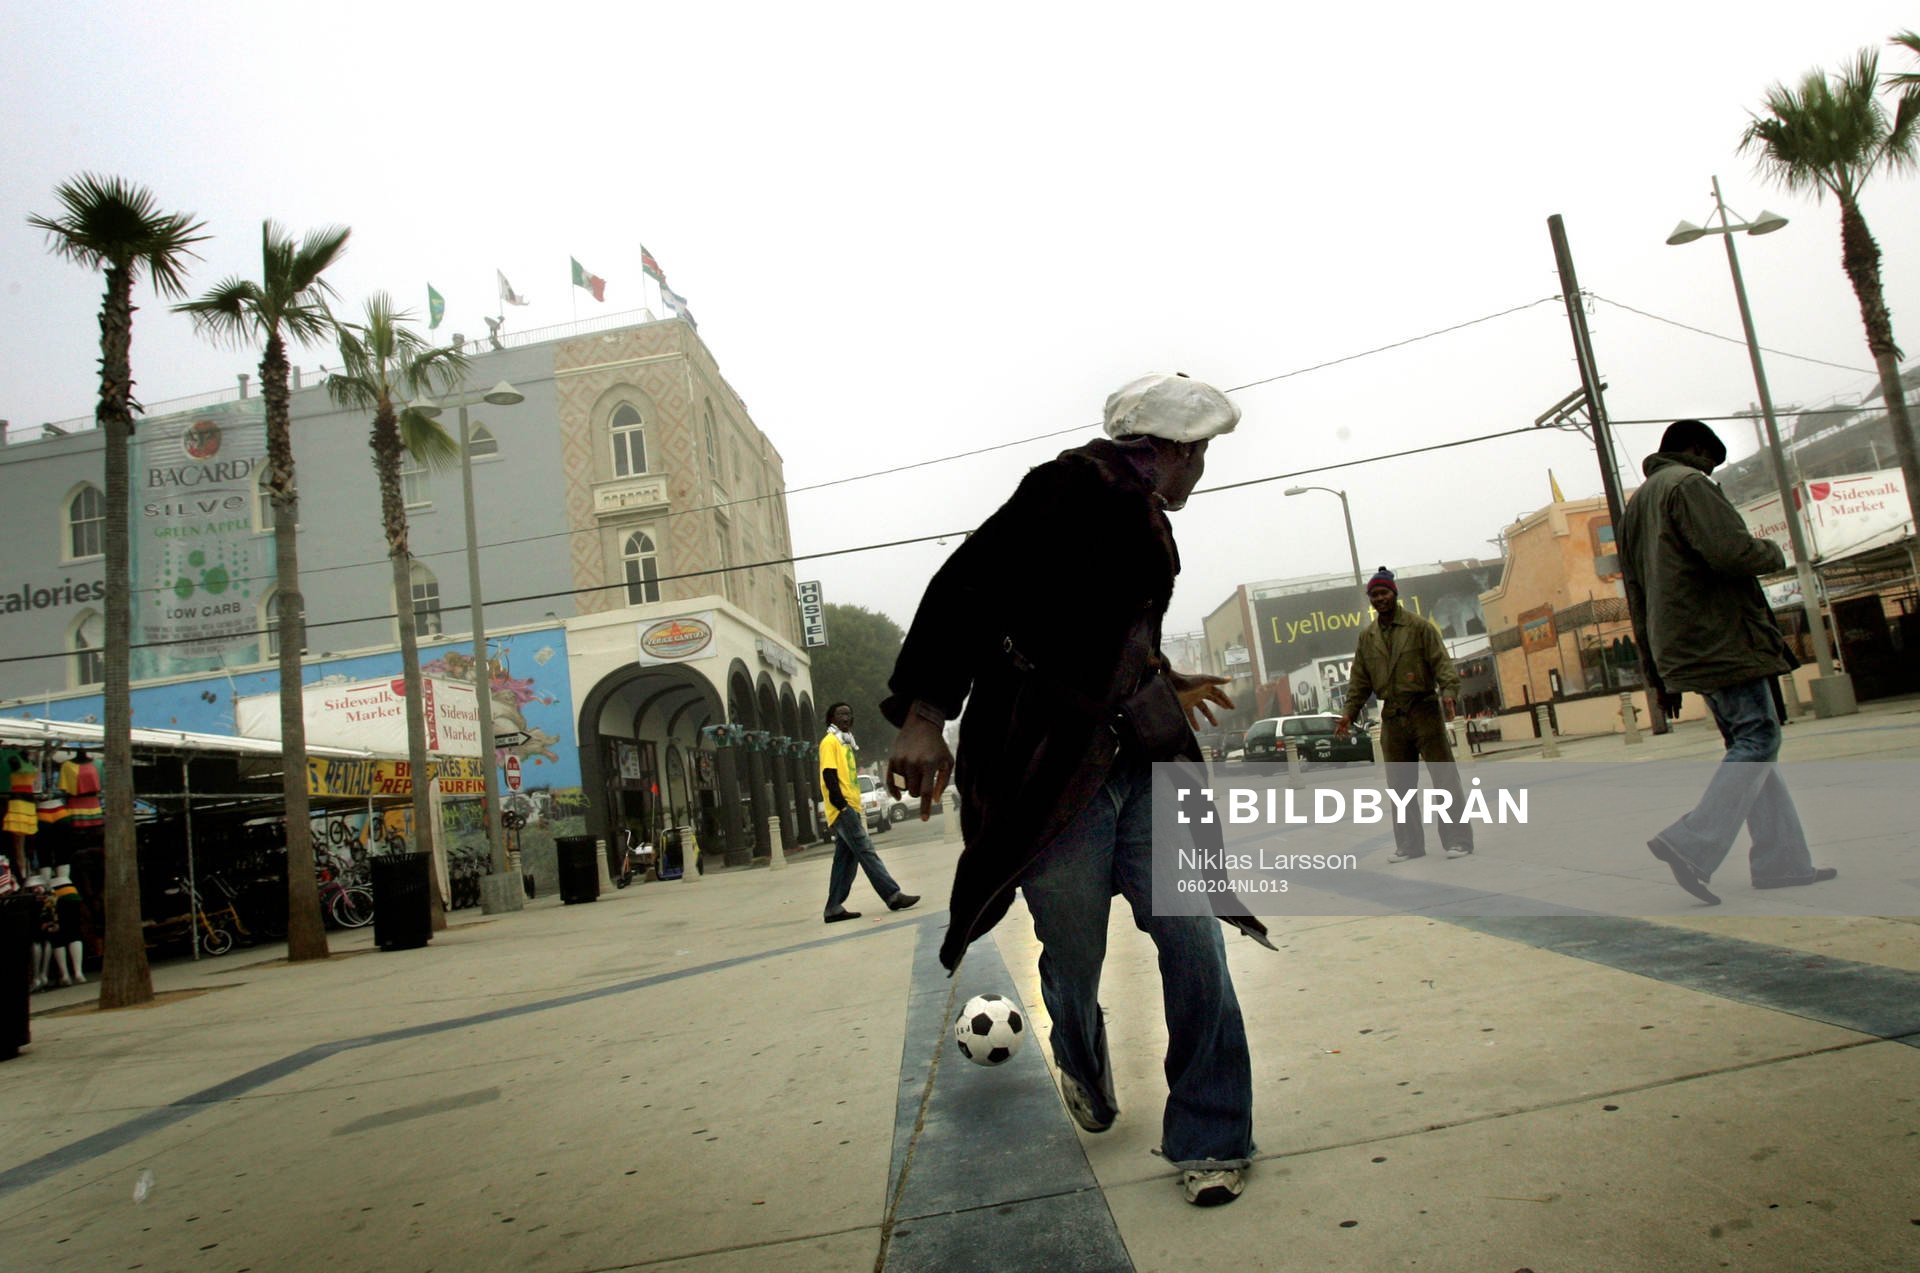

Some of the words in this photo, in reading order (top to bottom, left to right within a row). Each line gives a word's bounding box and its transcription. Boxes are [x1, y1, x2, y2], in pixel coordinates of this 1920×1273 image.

[1832, 482, 1900, 501] Sidewalk
[1831, 500, 1885, 516] Market
[154, 527, 200, 538] GREEN
[206, 519, 250, 534] APPLE
[1753, 520, 1787, 538] idewa
[167, 607, 198, 619] LOW
[202, 602, 241, 617] CARB
[801, 583, 824, 646] HOSTEL
[1286, 611, 1361, 643] yellow
[324, 691, 393, 711] Sidewalk
[346, 707, 402, 723] Market
[440, 703, 480, 721] Sidewal
[443, 725, 477, 742] Market
[439, 780, 487, 793] SURFIN
